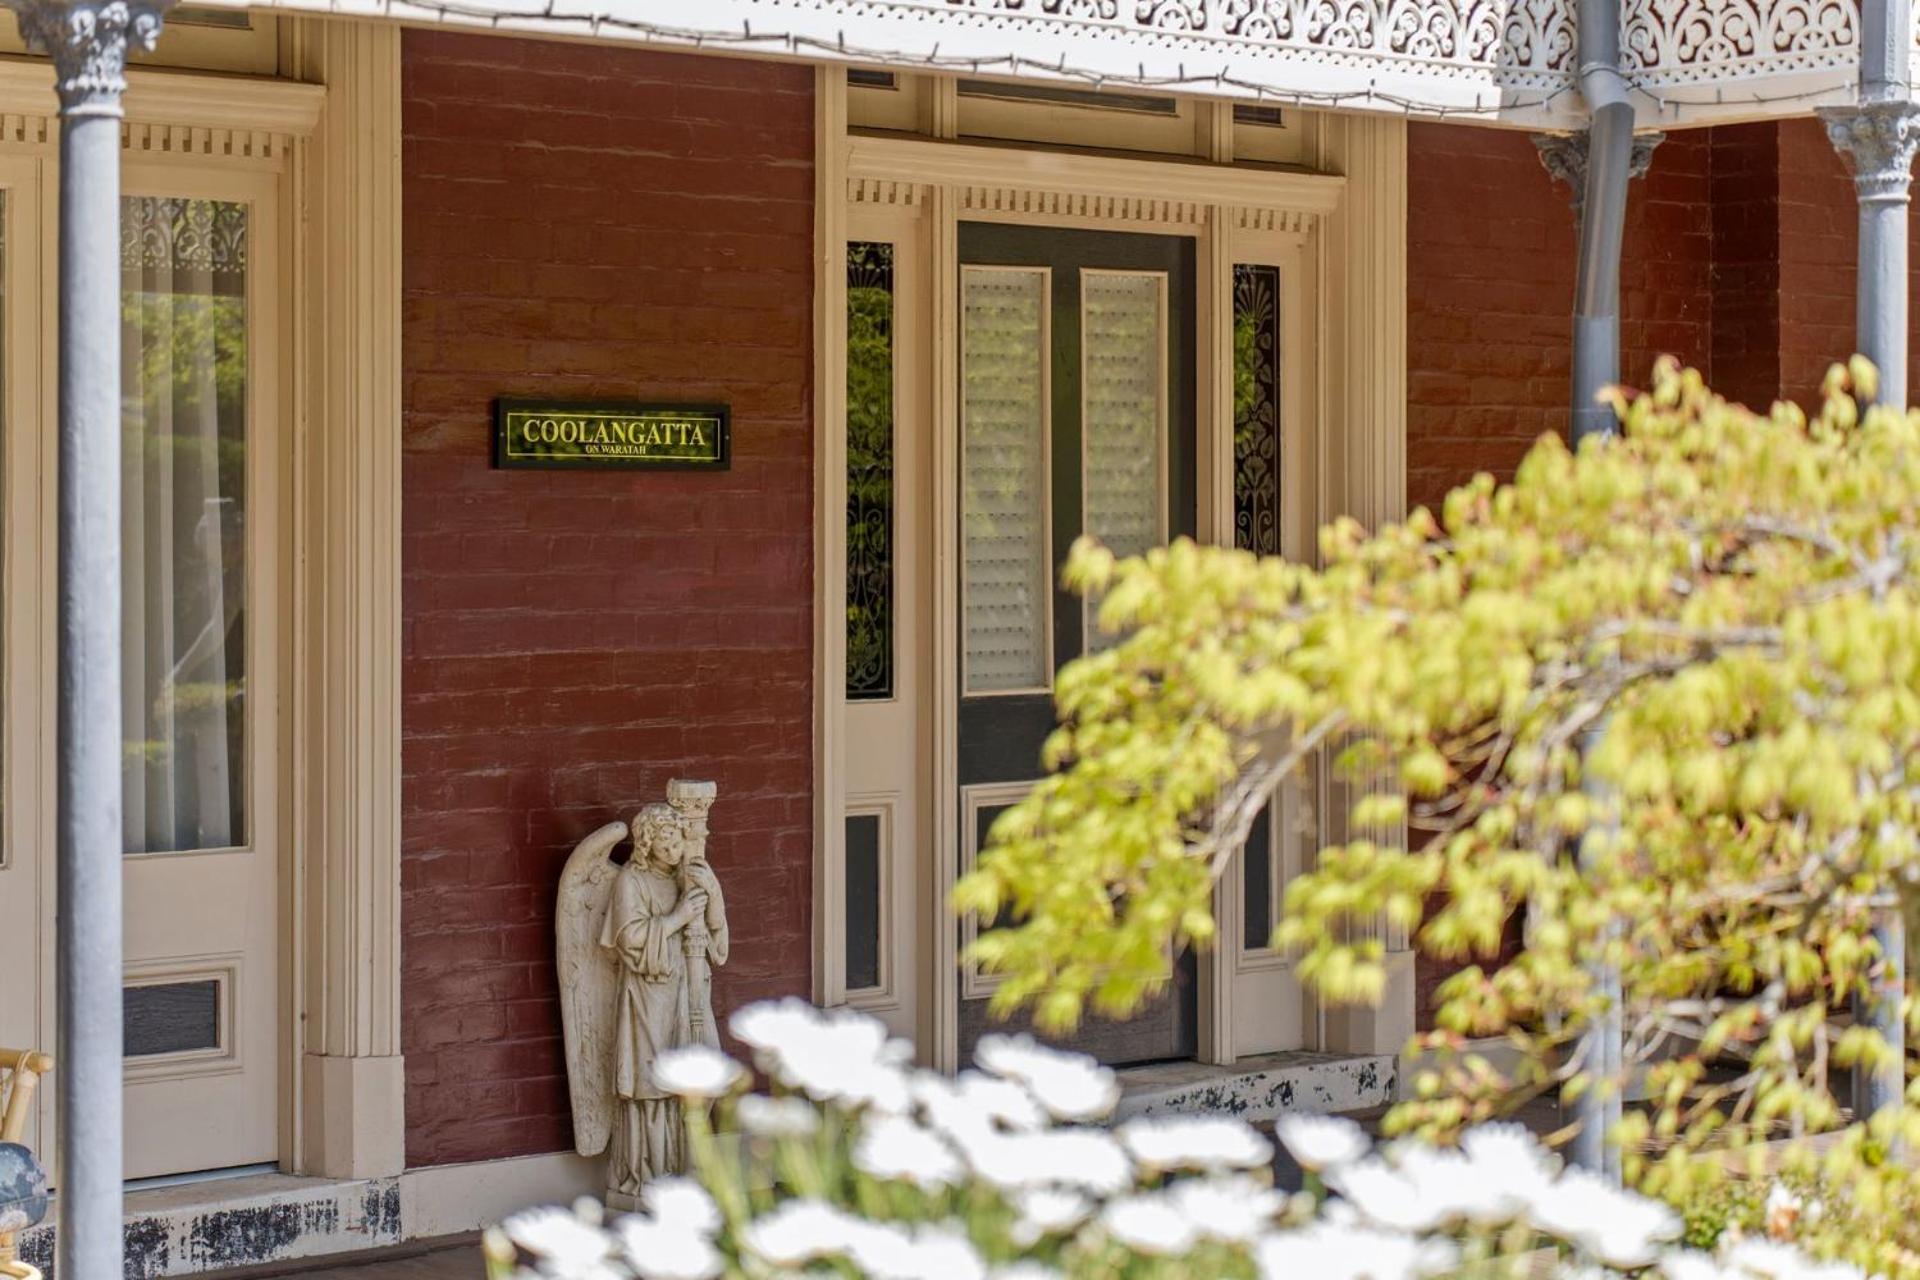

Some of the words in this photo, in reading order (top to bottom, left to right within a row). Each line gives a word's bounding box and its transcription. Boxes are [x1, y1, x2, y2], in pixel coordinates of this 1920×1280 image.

[523, 419, 706, 445] COOLANGATTA
[585, 444, 600, 454] ON
[601, 444, 646, 455] WARATAH
